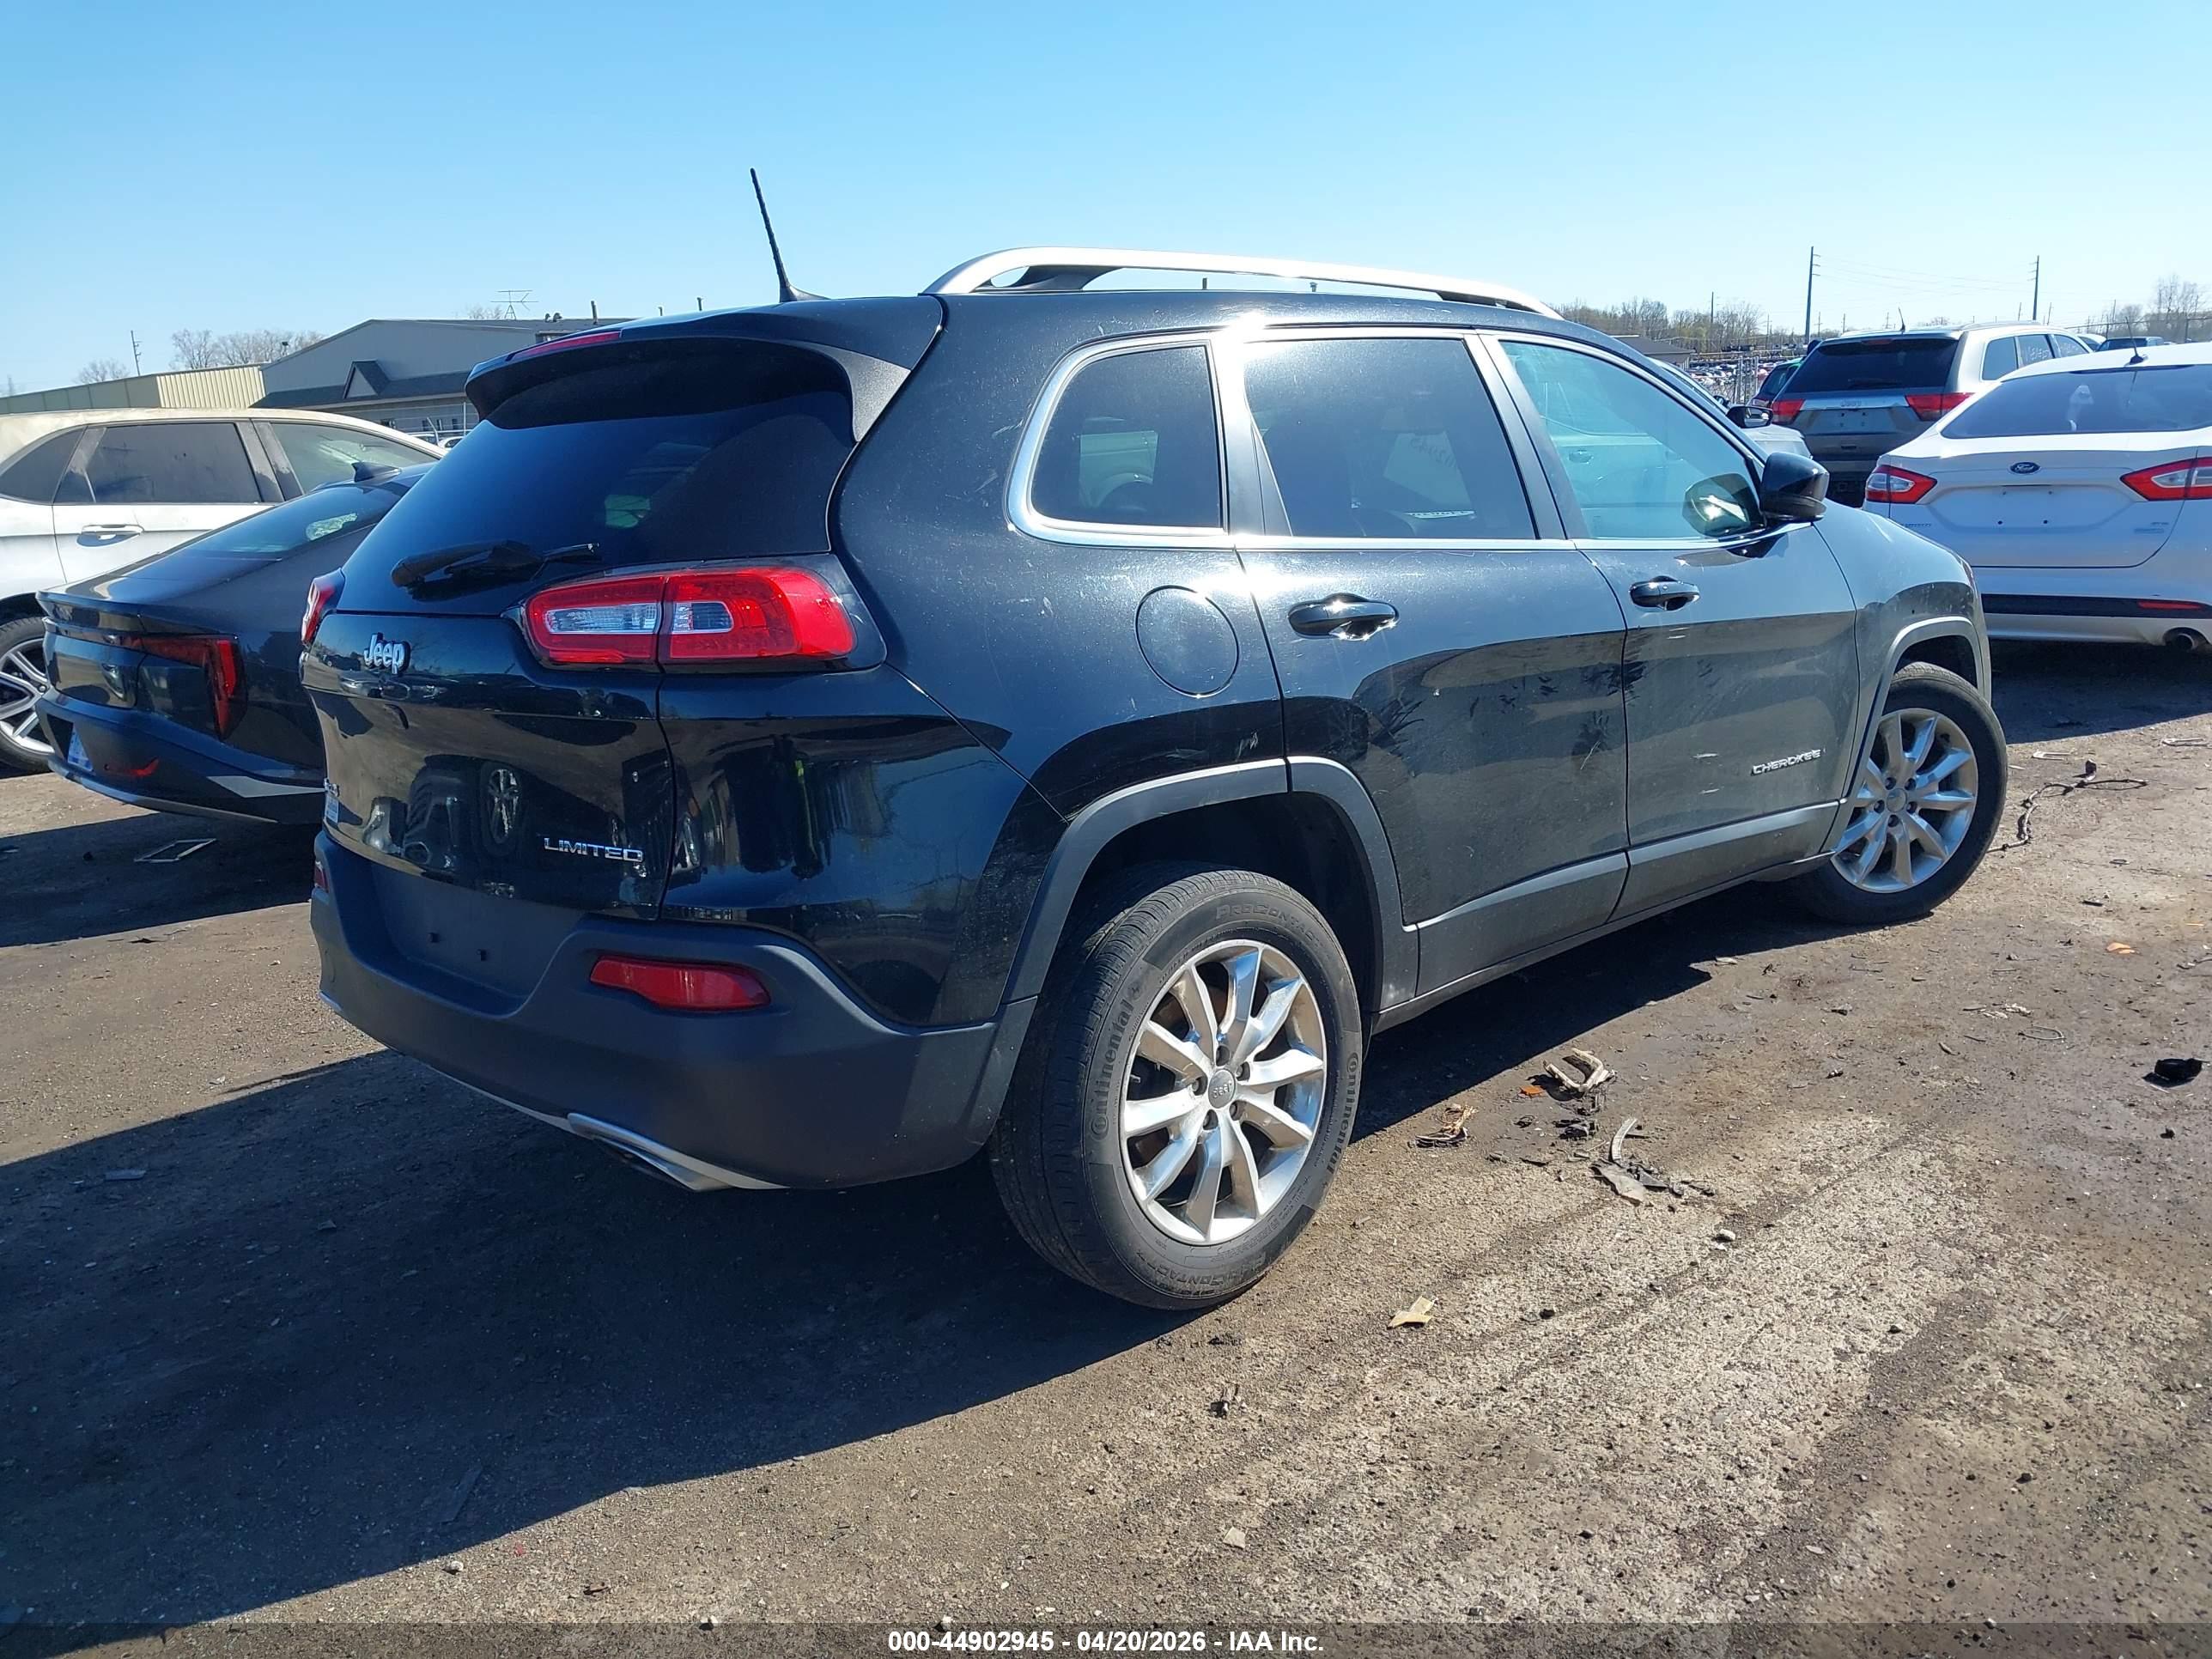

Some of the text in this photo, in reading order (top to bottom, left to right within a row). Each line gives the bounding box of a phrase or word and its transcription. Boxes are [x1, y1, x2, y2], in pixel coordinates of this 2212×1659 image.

[363, 633, 405, 674] Jeep
[1752, 749, 1821, 775] CHEROKEE
[544, 837, 644, 862] LIMITED
